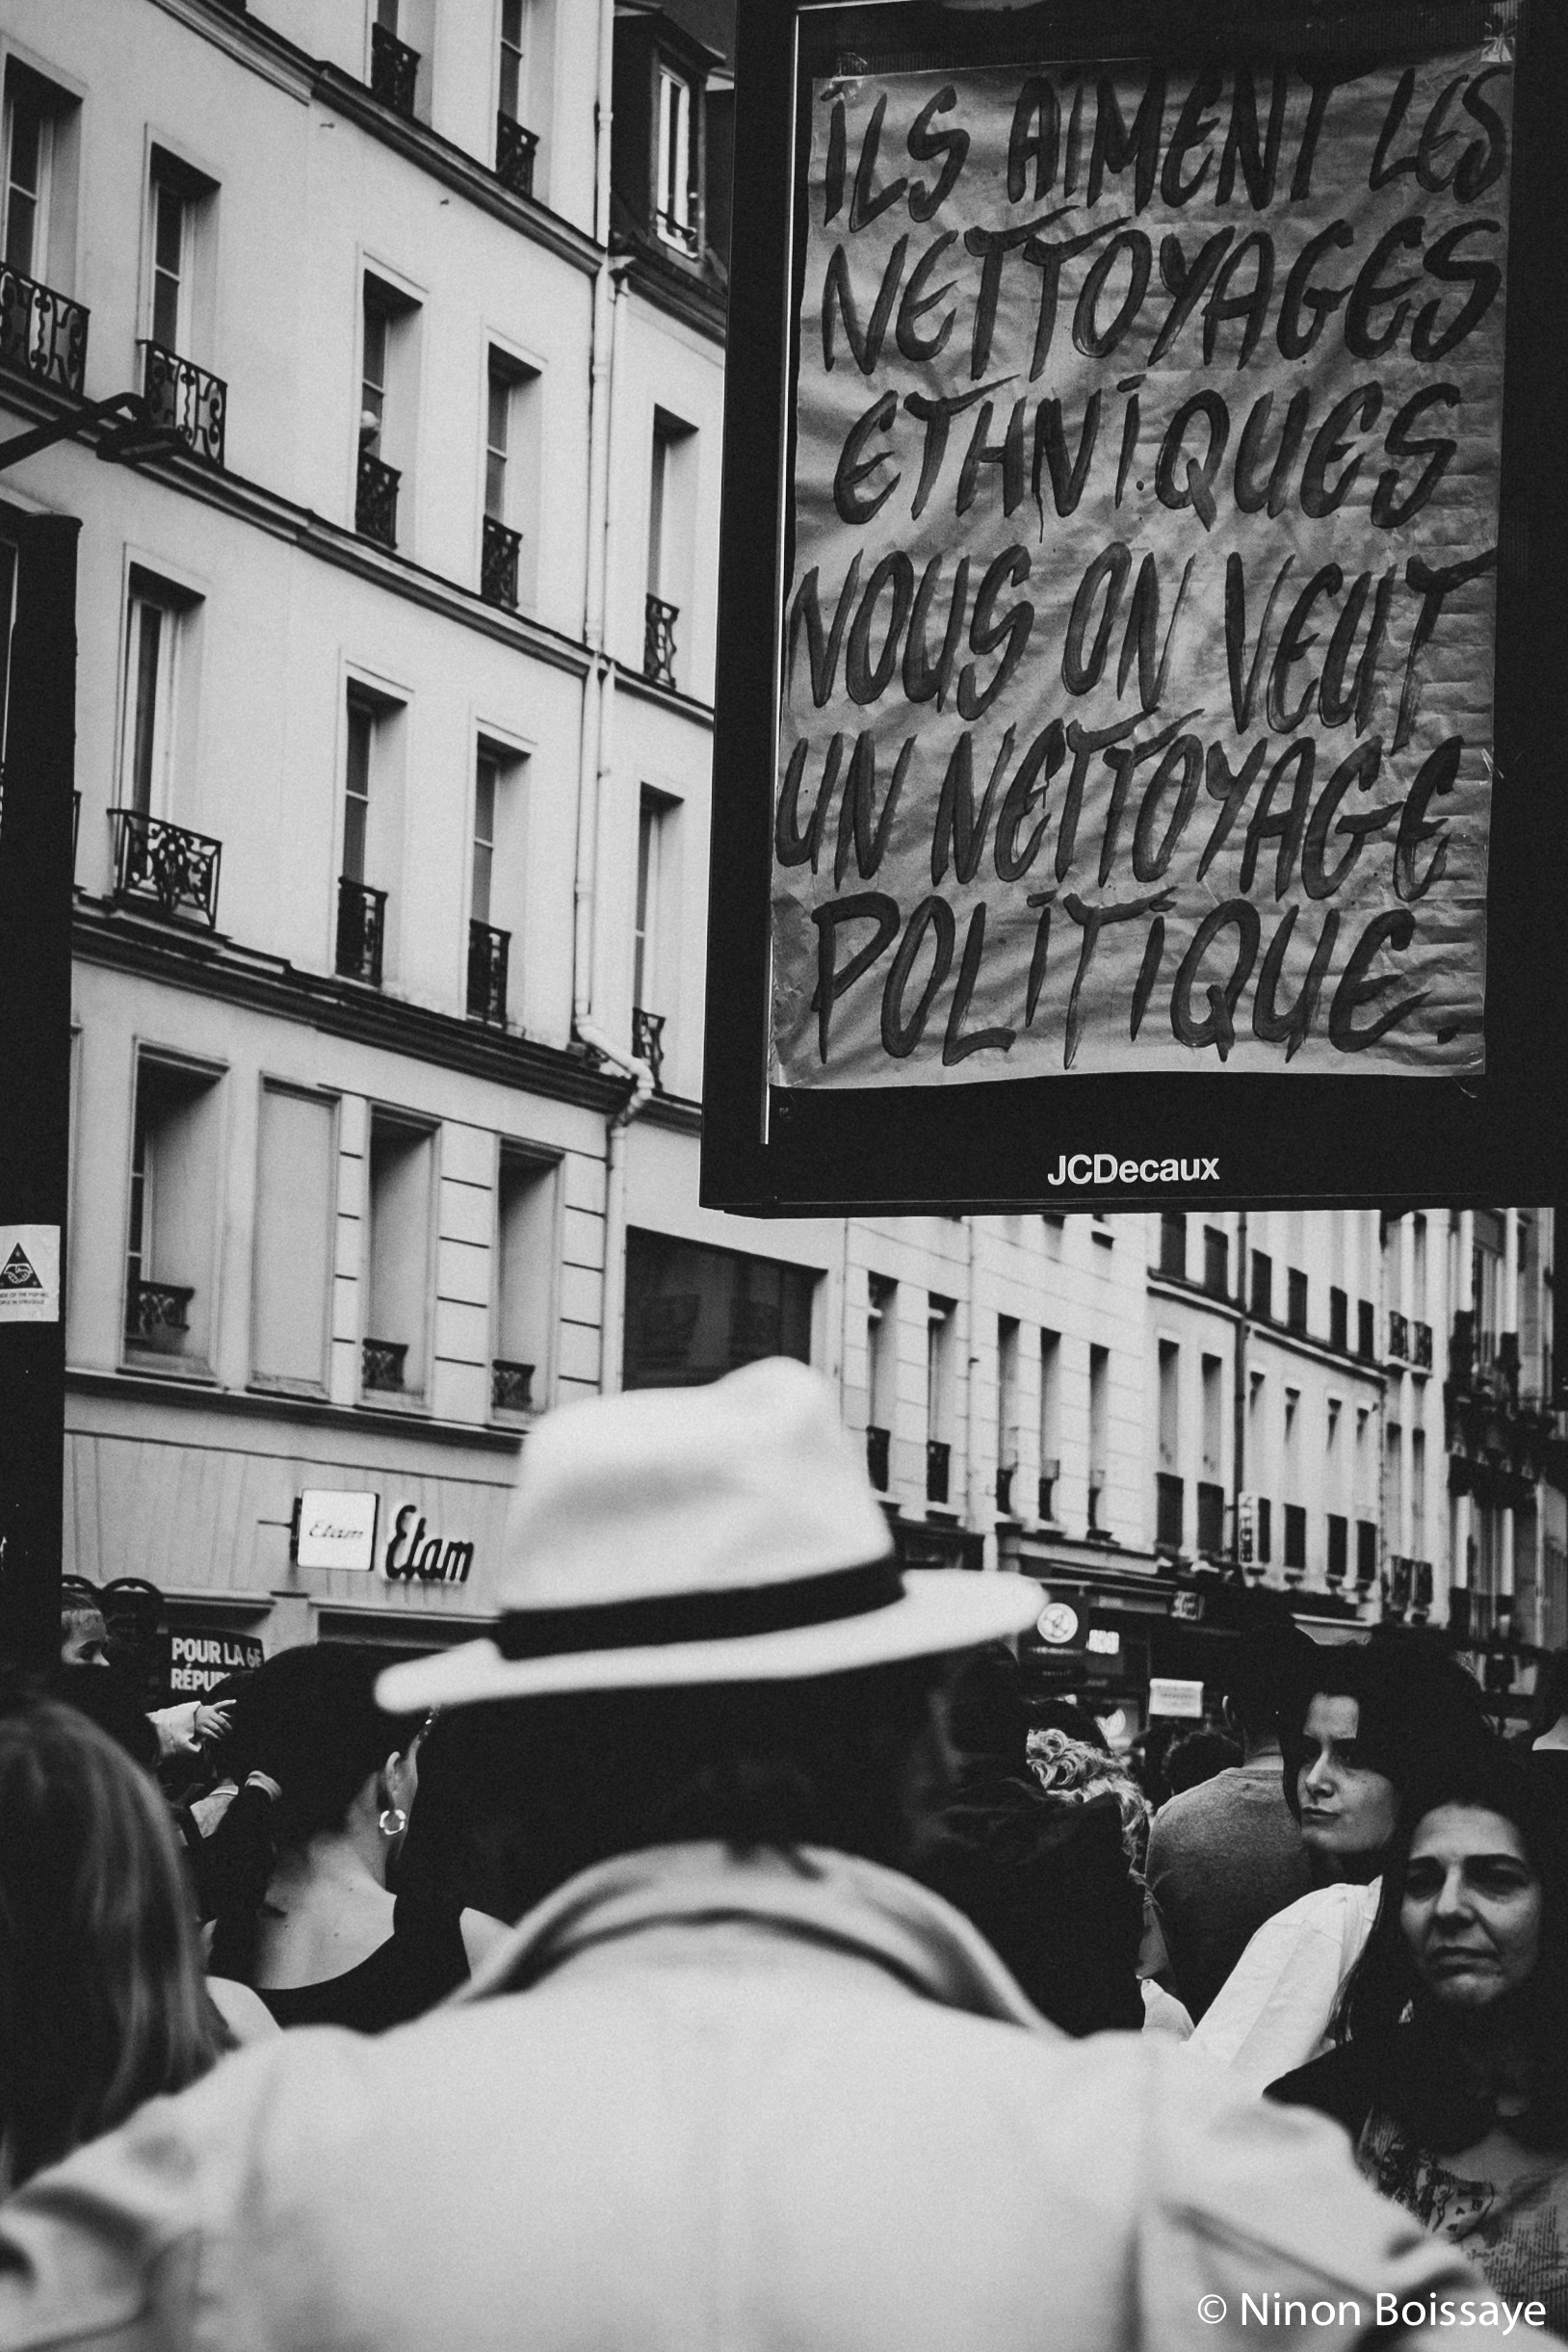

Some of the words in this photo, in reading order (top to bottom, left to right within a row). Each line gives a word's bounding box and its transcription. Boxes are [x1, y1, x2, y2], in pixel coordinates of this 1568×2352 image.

[1008, 65, 1373, 215] AIMENT
[1370, 66, 1510, 203] LES
[822, 206, 1503, 381] NETTOYAGES
[833, 375, 1461, 541] ETHNIQUES
[787, 544, 1034, 720] NOUS
[1062, 541, 1195, 712] ON
[1225, 549, 1499, 755] VEUT
[774, 730, 917, 890] UN
[930, 707, 1465, 902] NETTOYAGE
[1047, 1154, 1220, 1187] JCDecaux
[309, 1522, 364, 1538] Etam
[386, 1504, 474, 1582] Etam
[172, 1637, 222, 1664] POUR
[223, 1642, 245, 1666] LA
